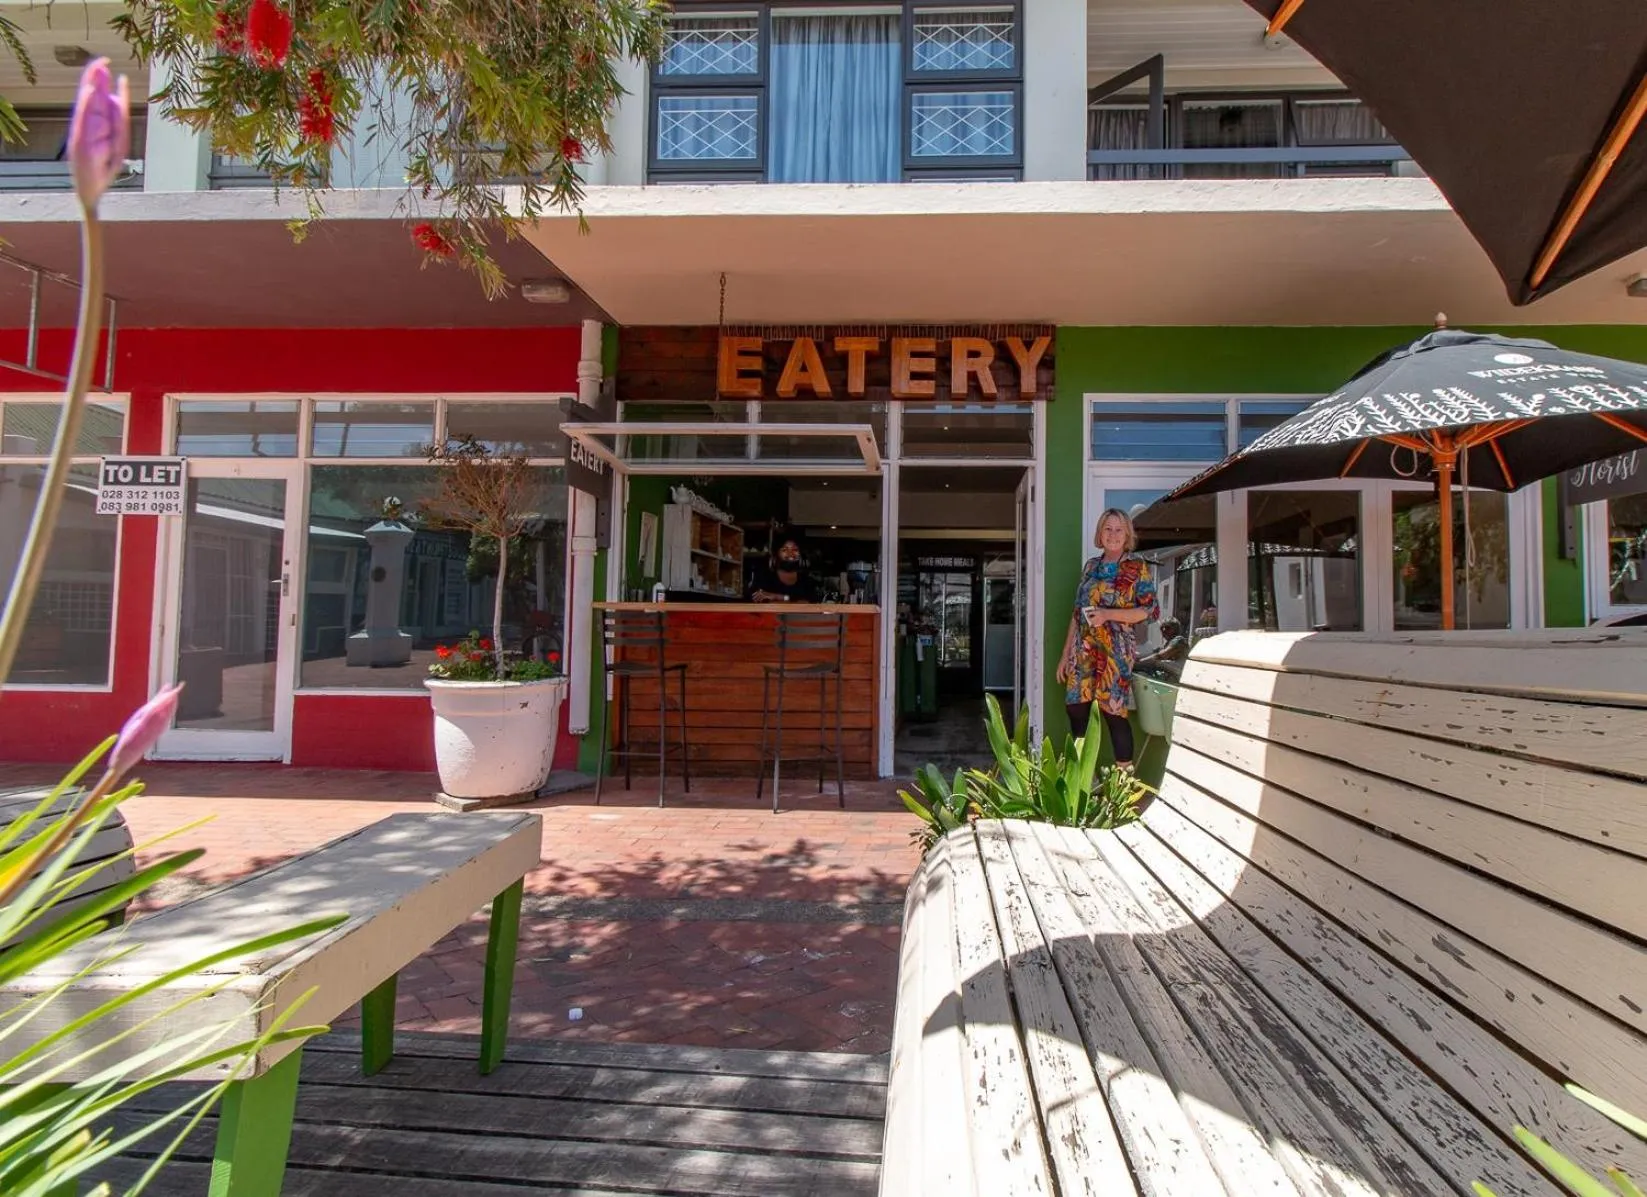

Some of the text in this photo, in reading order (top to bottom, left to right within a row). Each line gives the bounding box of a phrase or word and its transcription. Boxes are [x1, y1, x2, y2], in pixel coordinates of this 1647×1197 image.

[717, 336, 1051, 398] EATERY
[105, 464, 181, 483] TO LET
[102, 490, 180, 500] 028 312 1103
[101, 502, 179, 512] 083 981 0981
